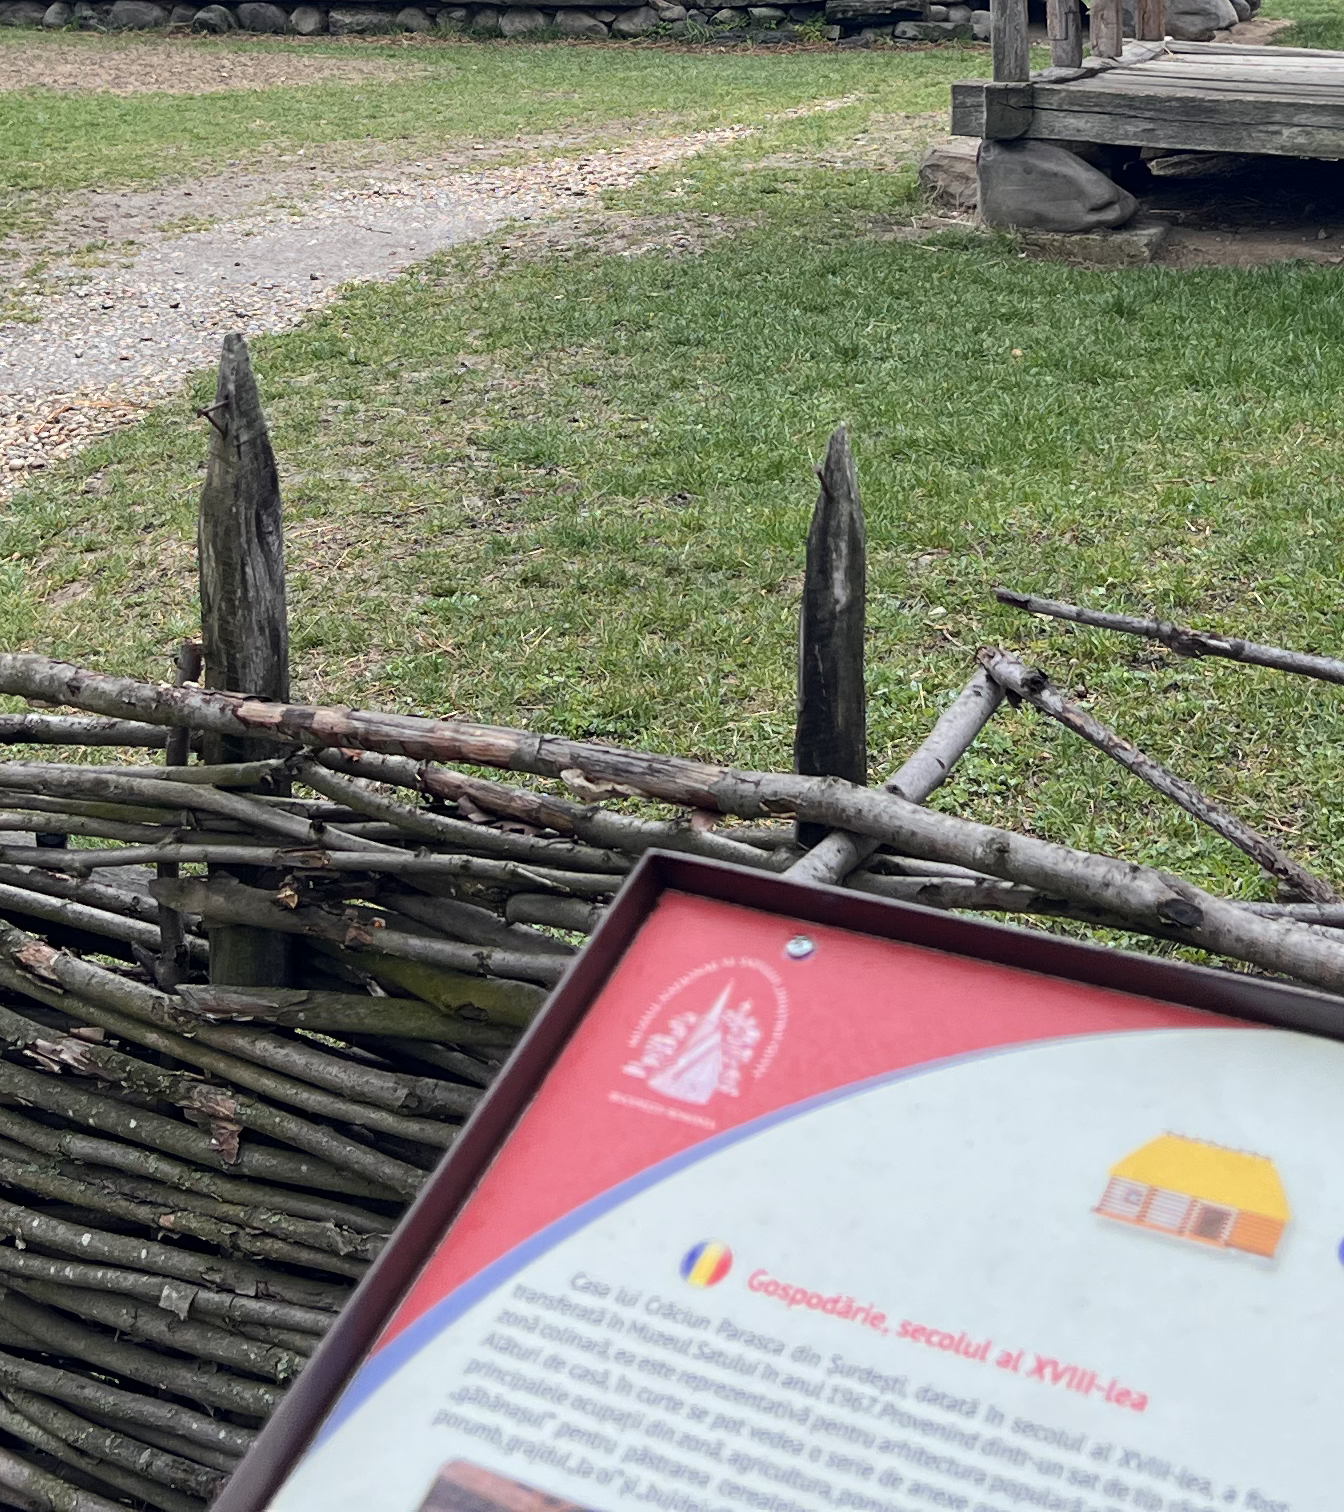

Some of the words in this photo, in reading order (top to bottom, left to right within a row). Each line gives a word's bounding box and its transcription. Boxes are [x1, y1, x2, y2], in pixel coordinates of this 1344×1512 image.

[463, 1359, 571, 1405] principalele
[643, 1420, 676, 1444] din
[481, 1332, 543, 1364] Alături
[635, 1387, 685, 1414] curte
[709, 1413, 748, 1436] pot
[749, 1426, 806, 1456] vedea
[825, 1452, 875, 1480] serie
[907, 1480, 969, 1512] anexe
[495, 1309, 541, 1334] zonă
[635, 1357, 678, 1380] este
[809, 1414, 877, 1449] pentru
[874, 1437, 991, 1487] arhitectura
[512, 1284, 608, 1326] transferată
[626, 1320, 694, 1356] Muzeul
[692, 1341, 761, 1377] Satului
[780, 1374, 825, 1400] anul
[1066, 1467, 1101, 1491] sat
[570, 1272, 611, 1299] Casa
[614, 1287, 641, 1307] lui
[715, 1318, 785, 1356] Parasca
[790, 1346, 822, 1367] din
[913, 1385, 980, 1419] datată
[1011, 1417, 1087, 1454] secolul
[748, 1268, 889, 1336] Gospodărie,
[897, 1319, 992, 1362] secolul
[996, 1349, 1024, 1372] al
[1027, 1353, 1149, 1413] XVIII-lea
[553, 1422, 618, 1455] pentru
